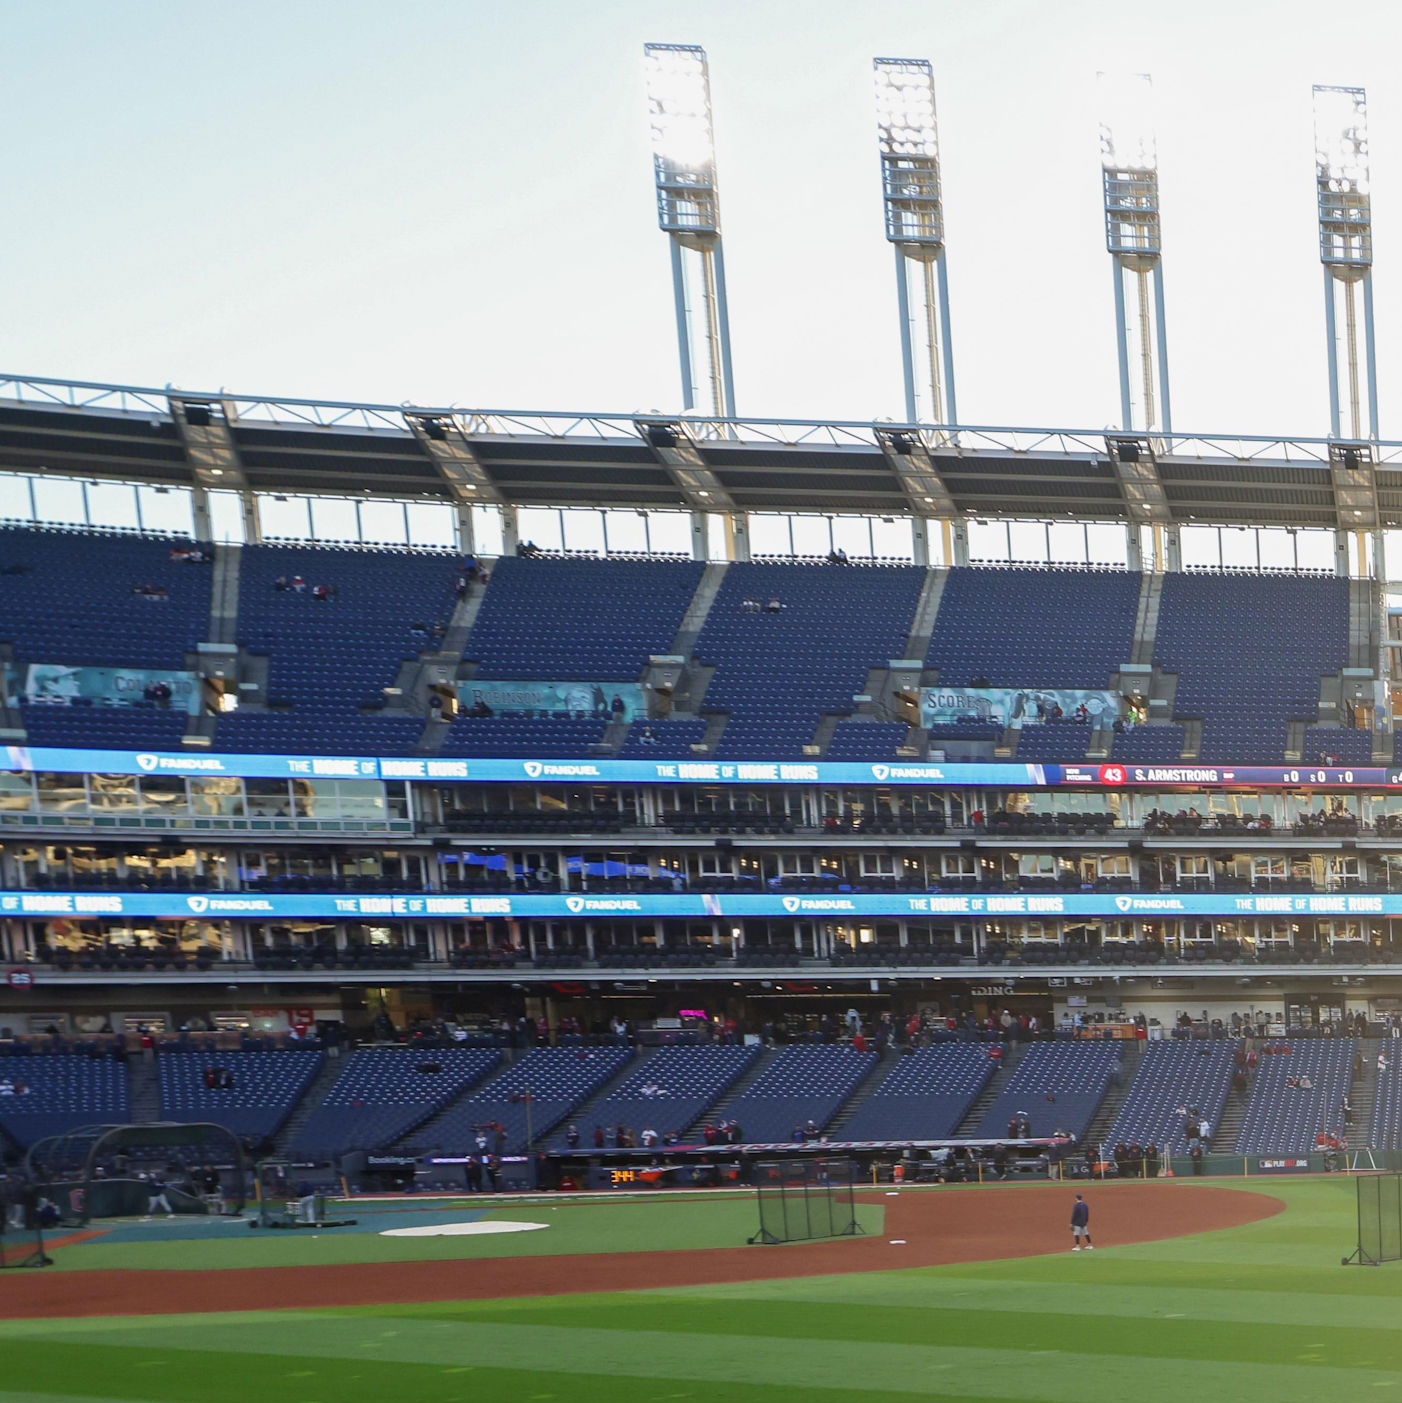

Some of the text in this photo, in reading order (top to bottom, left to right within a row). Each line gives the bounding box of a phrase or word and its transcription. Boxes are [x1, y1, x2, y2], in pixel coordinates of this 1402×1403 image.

[160, 758, 225, 770] FANDUEL
[543, 765, 600, 776] FANDUEL
[656, 764, 676, 777] THE
[722, 765, 735, 777] OF
[890, 768, 944, 779] FANDUEL
[1103, 768, 1122, 782] 43
[1135, 769, 1147, 781] S.
[1148, 769, 1218, 782] ARMSTRONG
[210, 899, 274, 911] FANDUEL
[585, 899, 642, 910] FANDUEL
[801, 899, 855, 910] FANDUEL
[909, 899, 928, 910] THE
[971, 899, 985, 910] OF
[1133, 899, 1184, 909] FANDUEL
[1235, 898, 1253, 910] THE
[1295, 898, 1307, 910] OF
